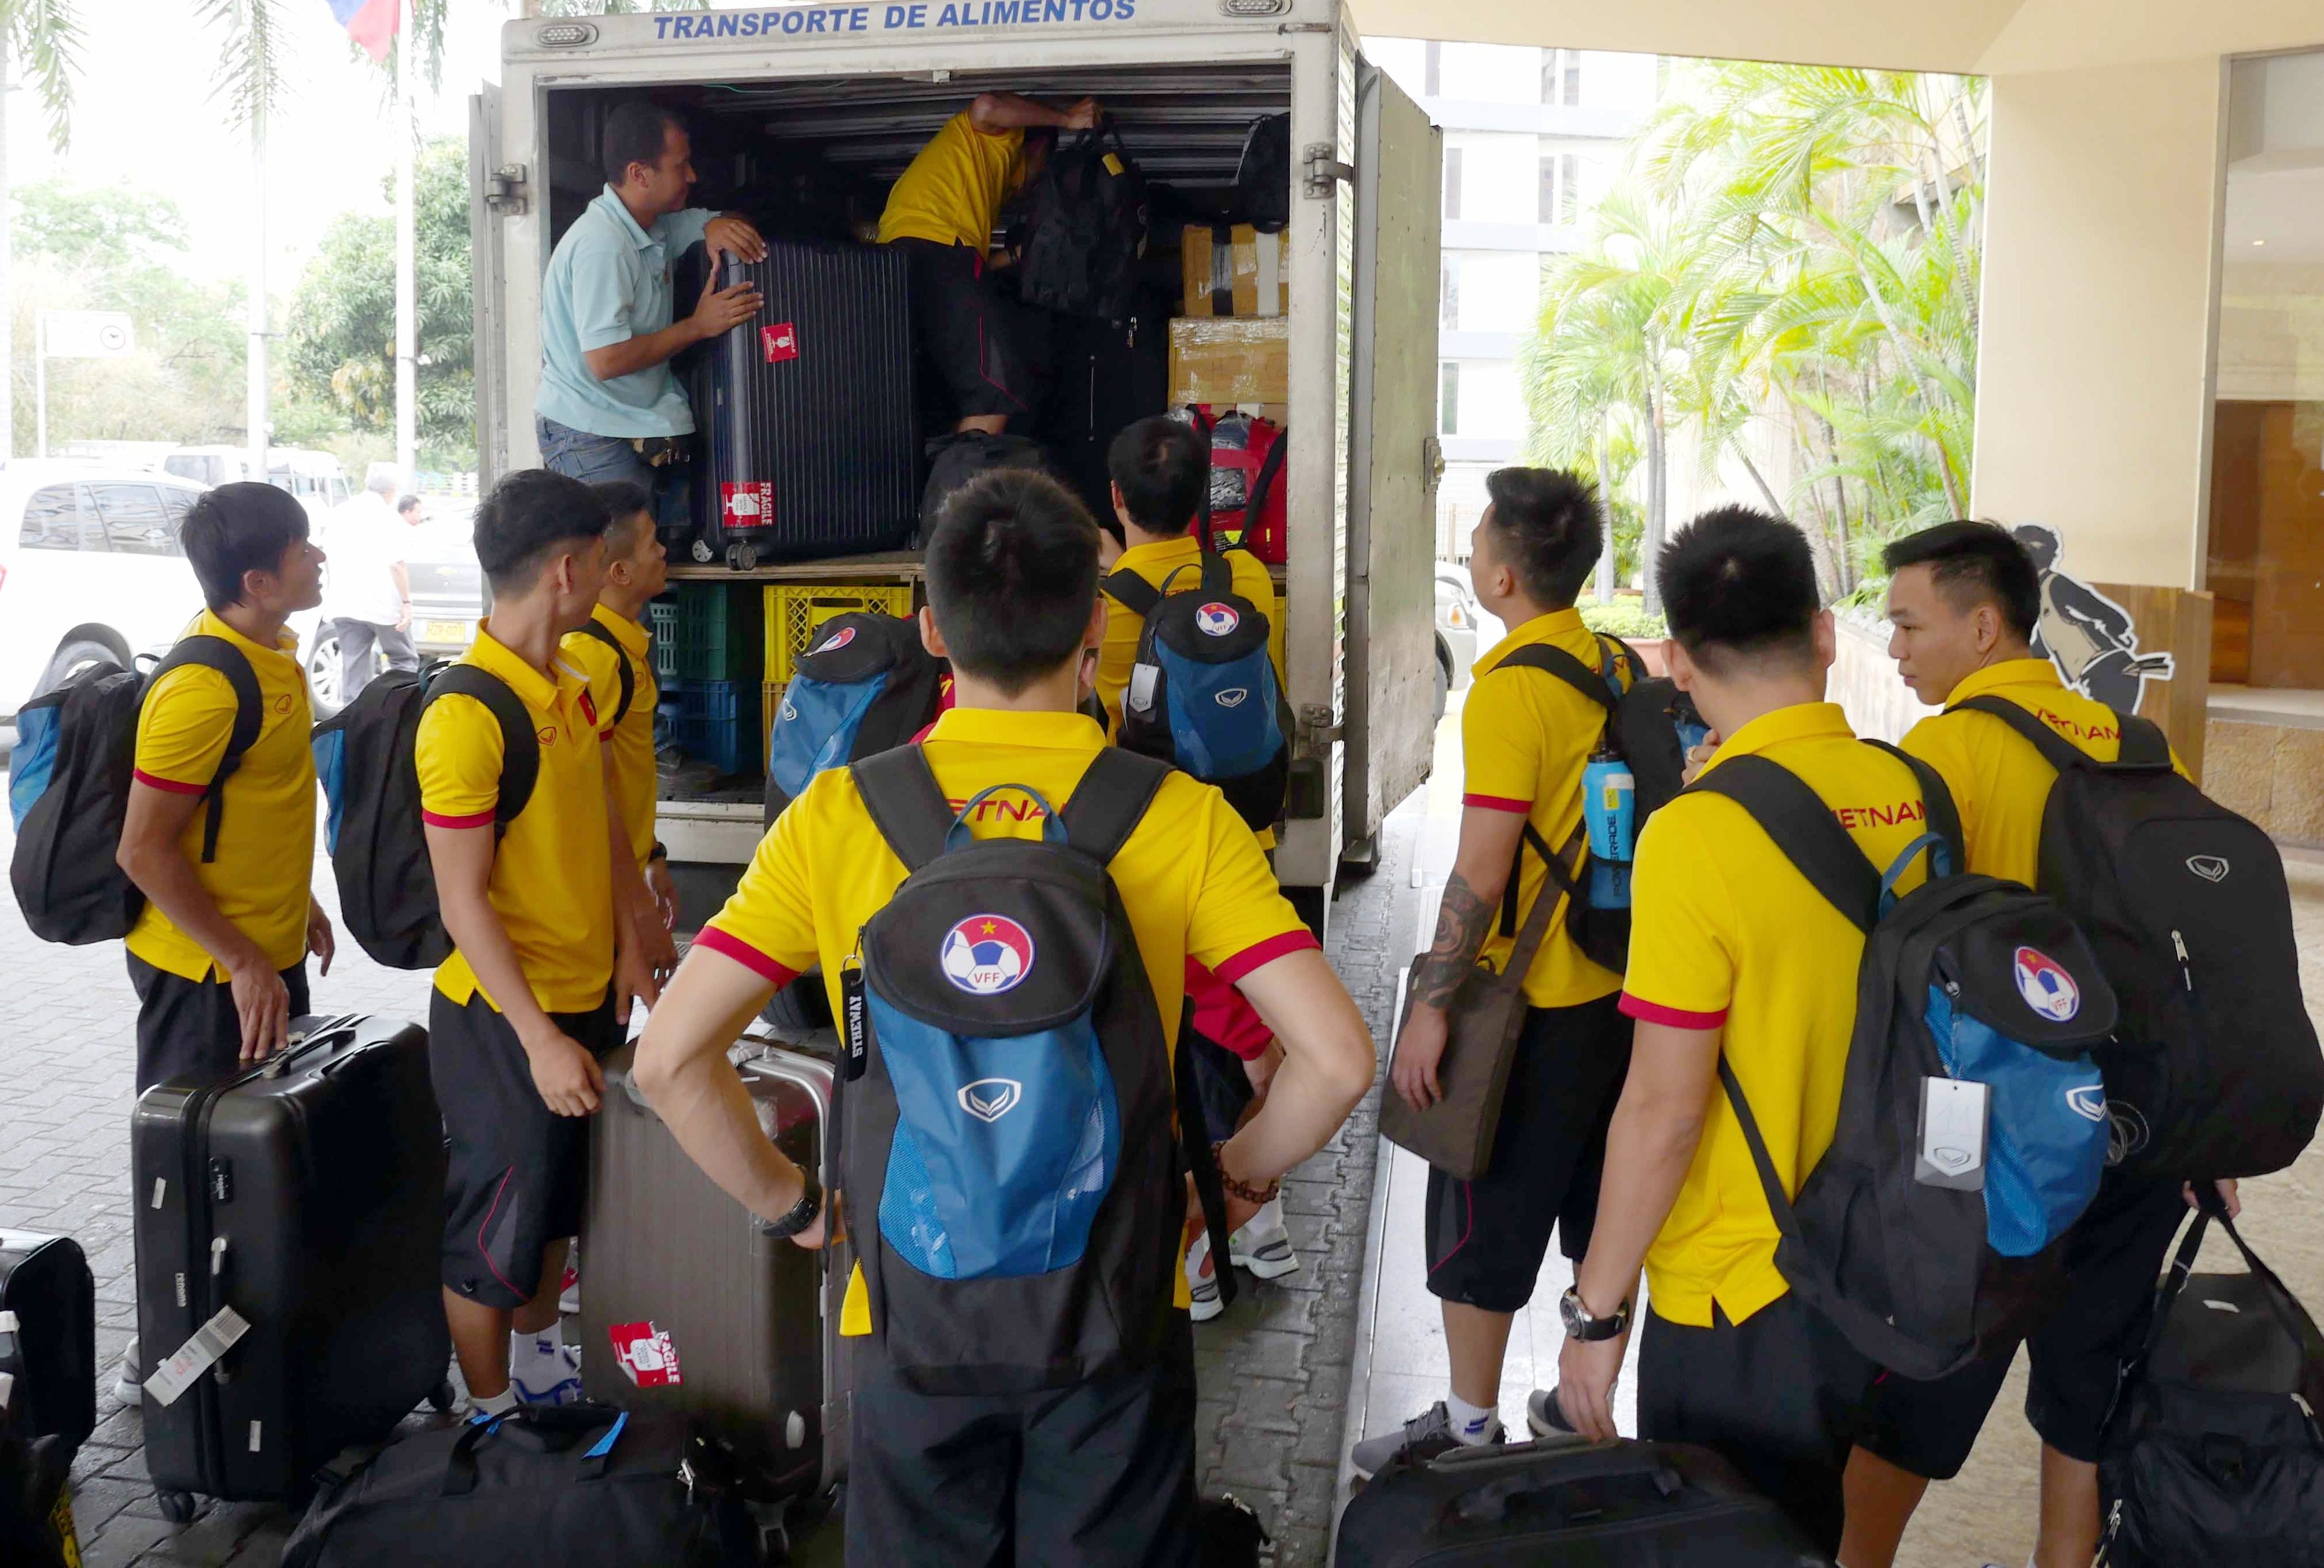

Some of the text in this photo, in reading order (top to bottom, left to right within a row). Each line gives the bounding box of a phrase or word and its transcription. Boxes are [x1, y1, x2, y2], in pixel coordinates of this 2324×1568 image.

[654, 0, 1135, 39] TRANSPORTE DE ALIMENTOS
[760, 482, 772, 524] FRAGILE
[1215, 624, 1227, 632] VFF
[974, 972, 1000, 983] VFF
[2051, 998, 2067, 1011] VFF
